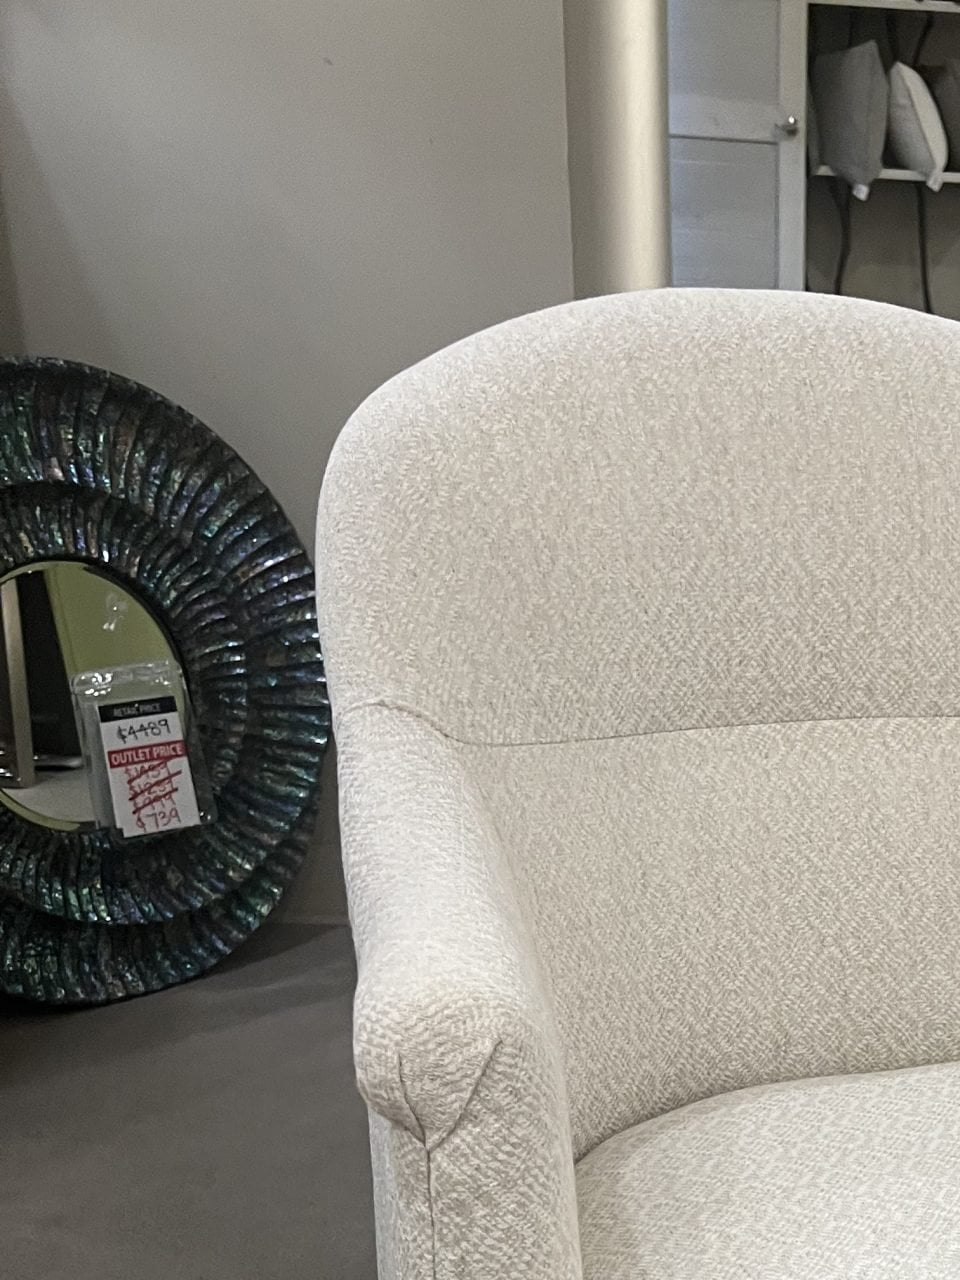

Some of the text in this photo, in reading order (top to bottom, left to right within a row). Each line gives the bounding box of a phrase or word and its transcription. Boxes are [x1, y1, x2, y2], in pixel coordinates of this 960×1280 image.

[116, 718, 171, 744] $4489
[111, 742, 182, 766] OUTLET PRICE
[135, 807, 182, 833] $739
